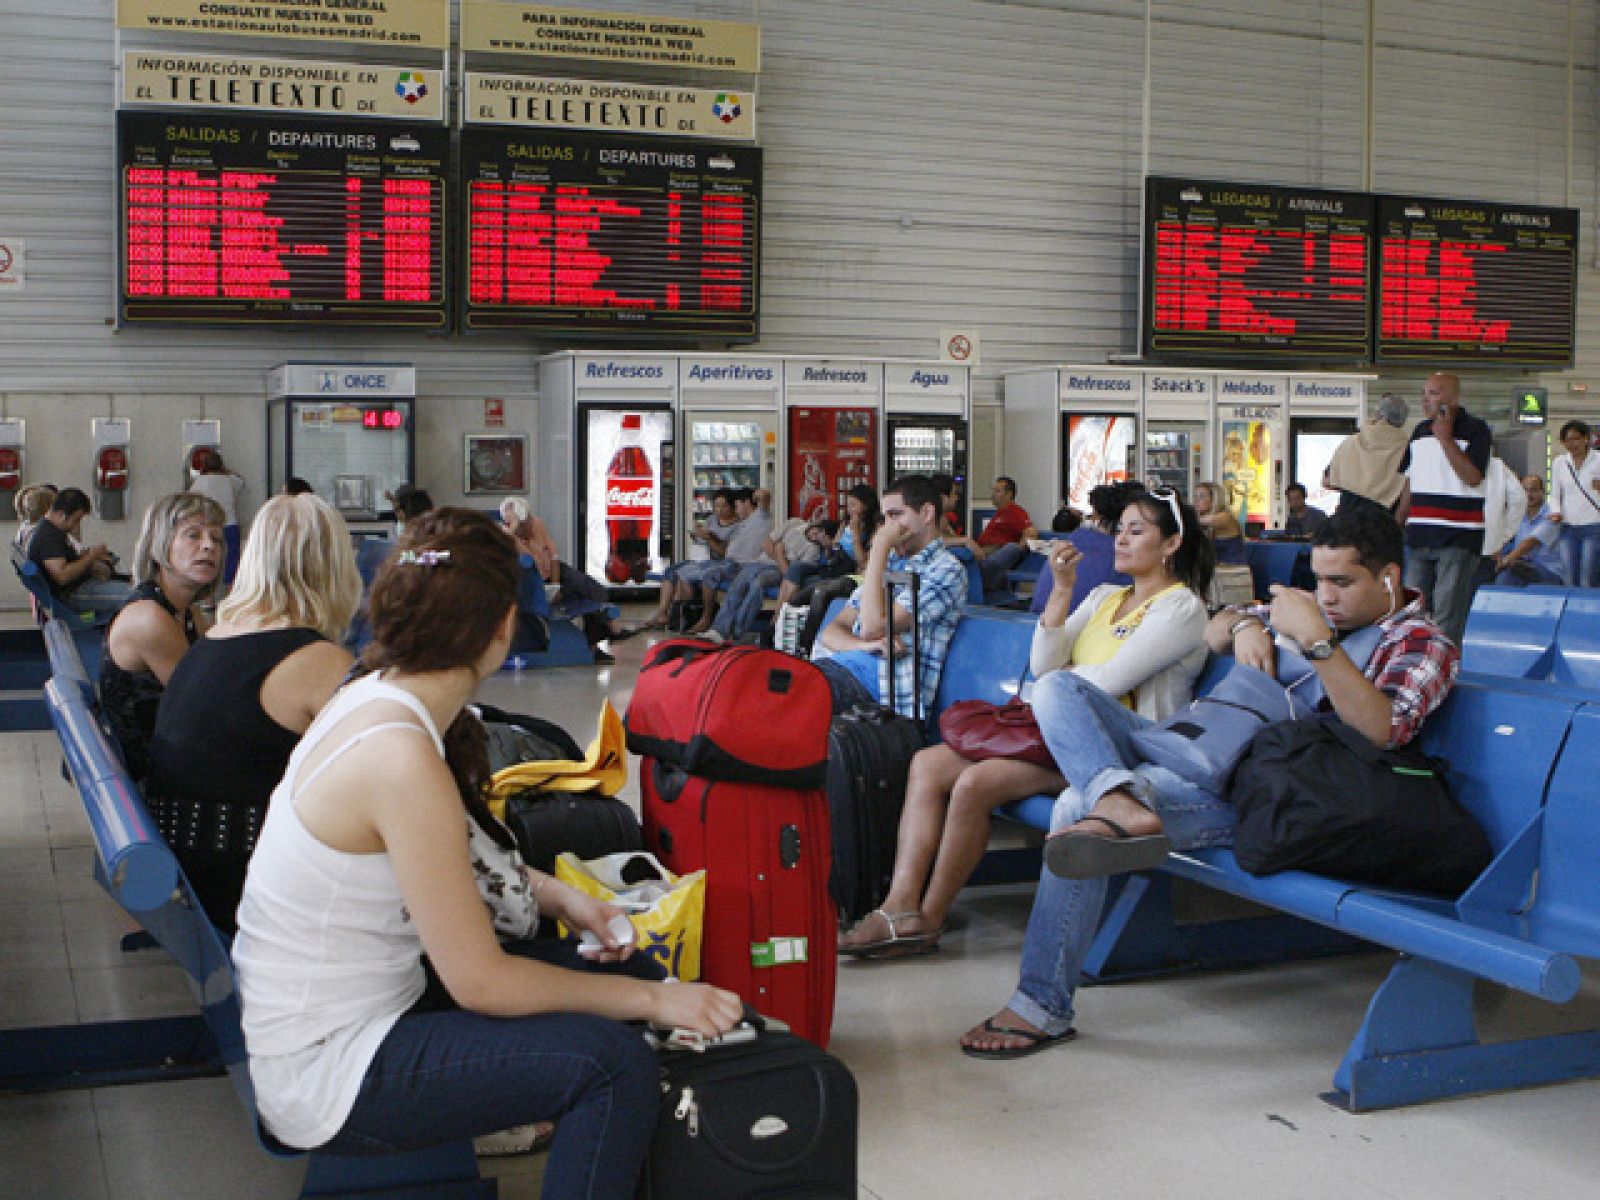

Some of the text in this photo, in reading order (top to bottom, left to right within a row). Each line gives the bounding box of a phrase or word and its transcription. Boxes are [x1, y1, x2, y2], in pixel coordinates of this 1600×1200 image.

[199, 3, 374, 25] CONSULTE NUESTRA WEB
[522, 12, 556, 26] PARA
[649, 23, 705, 38] GENERAL
[147, 15, 422, 42] www.estacionautobusesmadrid.com
[535, 28, 693, 50] CONSULTE NUESTRA WEB
[137, 57, 379, 84] INFORMACIÓN DISPONIBLE EN
[136, 75, 376, 112] EL TELETEXTO DE
[479, 78, 696, 104] INFORMACIÓN DISPONIBLE EN
[479, 95, 696, 131] EL TELETEXTO DE
[165, 125, 241, 143] SALIDAS
[268, 130, 377, 150] DEPARTURES
[506, 144, 574, 161] SALIDAS
[599, 149, 697, 168] DEPARTURES
[344, 374, 387, 389] ONCE
[586, 362, 664, 380] Refrescos
[689, 363, 774, 382] Aperitivos
[803, 366, 868, 383] Refrescos
[909, 370, 951, 388] Agua
[1067, 376, 1131, 391] Refrescos
[1151, 377, 1206, 393] Snack's
[1294, 383, 1353, 398] Refrescos
